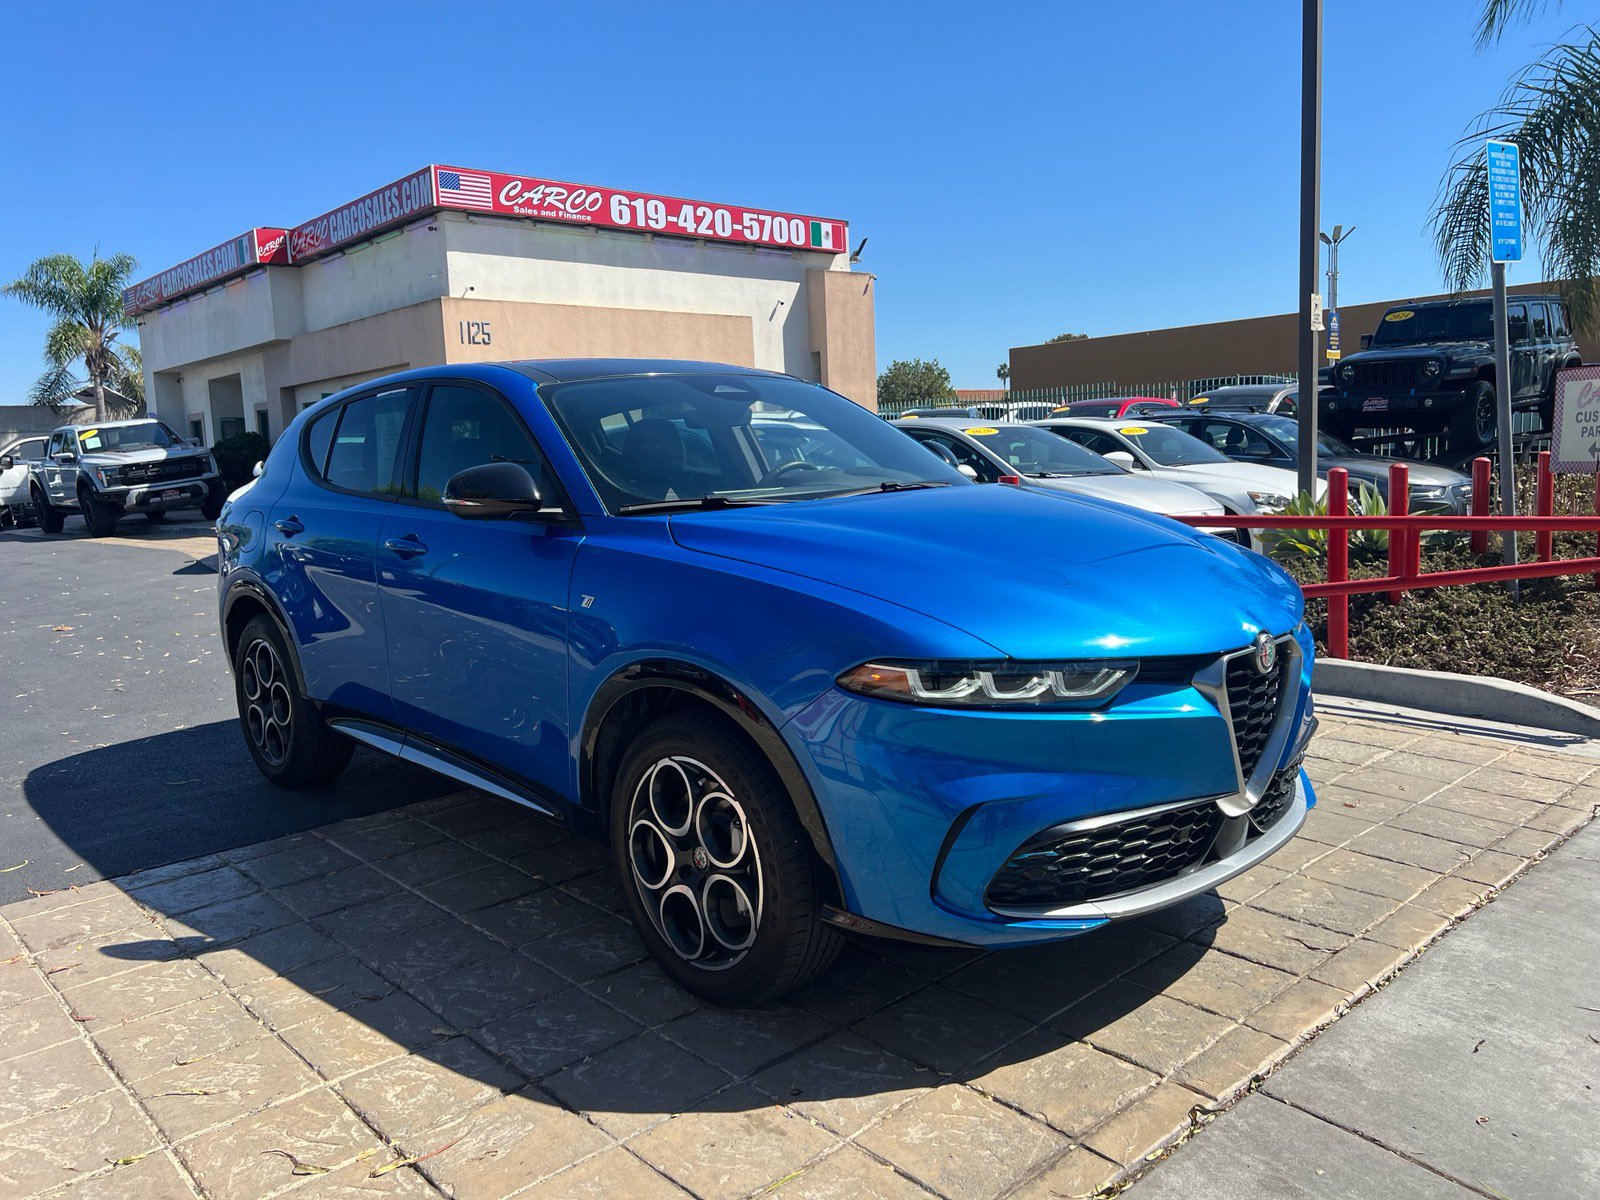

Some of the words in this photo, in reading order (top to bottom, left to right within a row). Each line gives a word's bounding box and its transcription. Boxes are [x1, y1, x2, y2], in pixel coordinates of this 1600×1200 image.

[330, 172, 433, 244] CARCOSALES.COM
[499, 180, 603, 214] CARCO
[609, 194, 806, 246] 619-420-5700
[513, 205, 538, 216] Sales
[540, 208, 556, 218] and
[558, 211, 592, 222] Finance
[161, 242, 238, 298] CARCOSALES.COM
[460, 321, 491, 345] 1125
